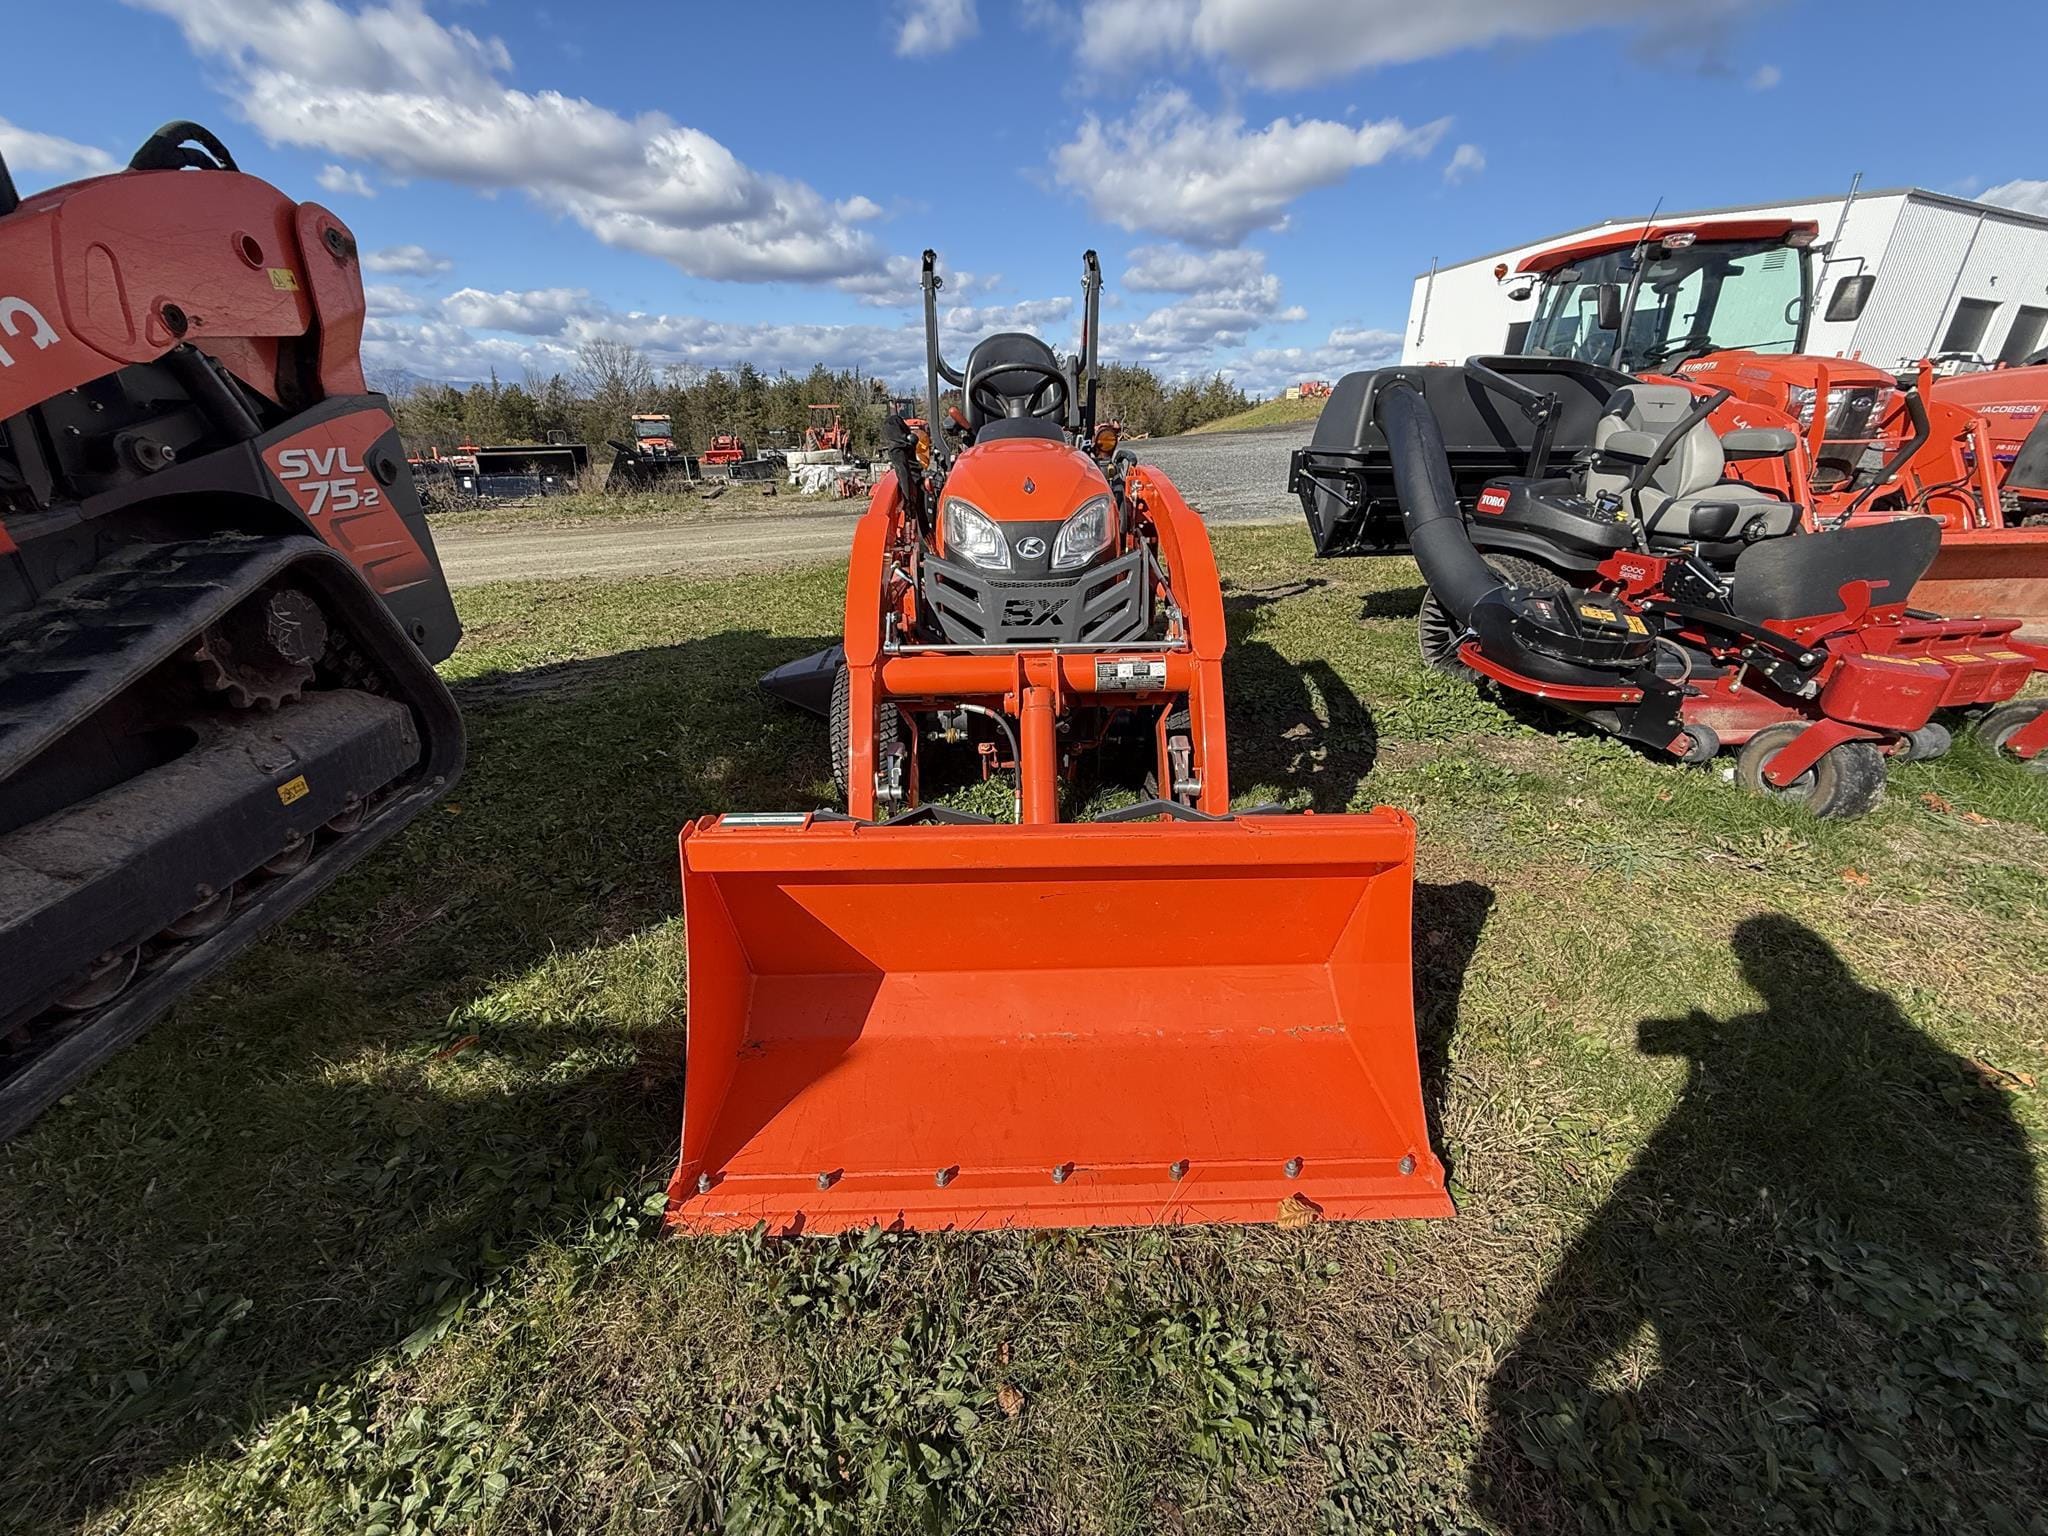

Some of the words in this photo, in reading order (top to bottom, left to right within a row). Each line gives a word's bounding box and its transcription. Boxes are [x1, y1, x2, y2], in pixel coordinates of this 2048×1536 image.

[1680, 361, 1719, 373] KUBOTA
[1977, 405, 2041, 413] JACOBSEN
[278, 447, 364, 479] SVL
[299, 478, 380, 515] 75-2
[1481, 494, 1506, 507] TORO
[1619, 570, 1643, 581] SERIES
[1620, 564, 1646, 575] 6000
[1001, 599, 1070, 626] BX
